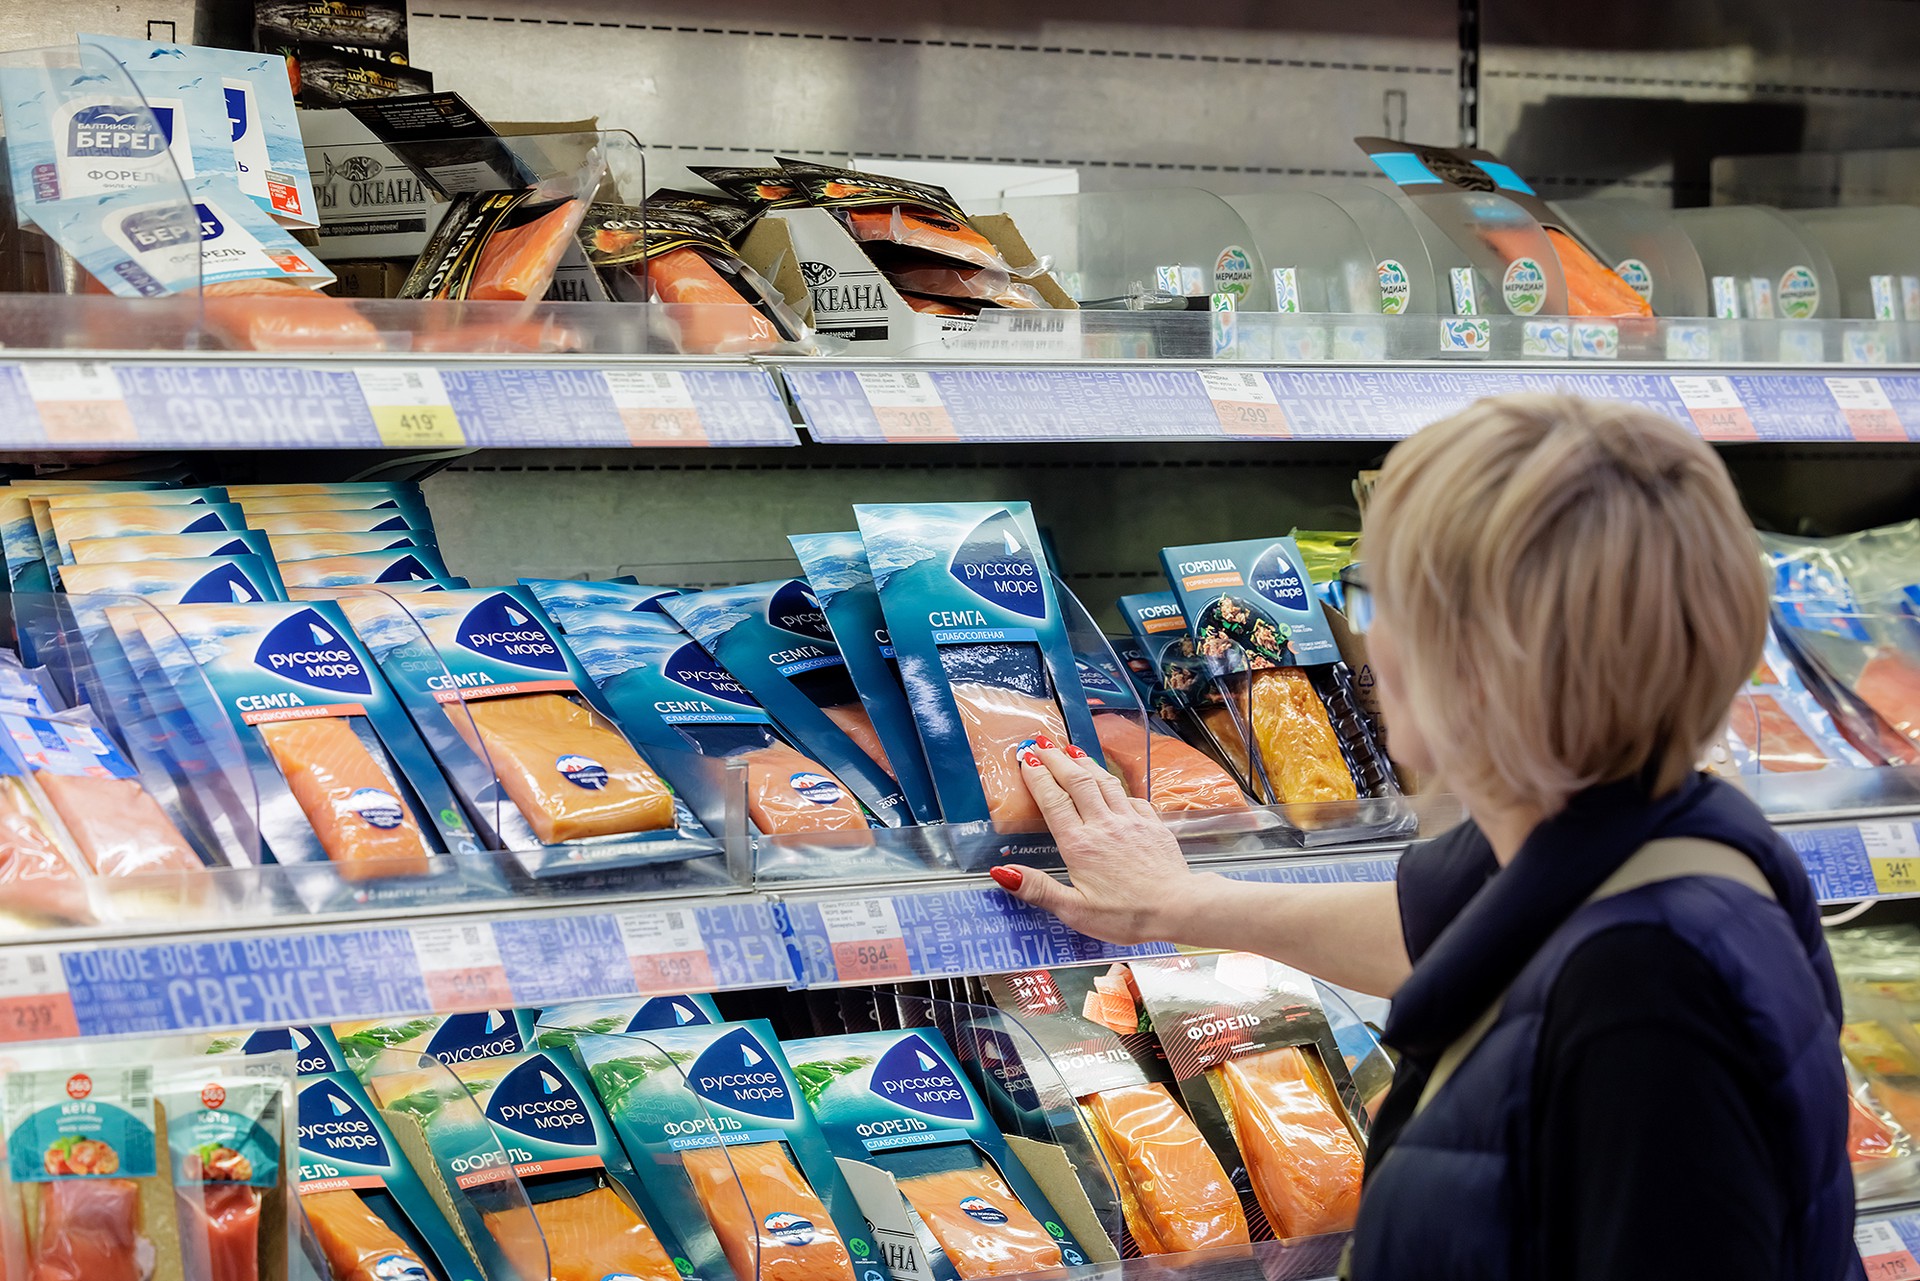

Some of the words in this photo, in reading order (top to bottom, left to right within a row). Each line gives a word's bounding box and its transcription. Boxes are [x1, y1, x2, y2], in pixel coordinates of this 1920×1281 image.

[76, 131, 161, 150] БЕРЕГ
[314, 183, 338, 209] РЫ
[350, 177, 426, 208] ОКЕАНА
[835, 177, 941, 204] ФОРЕЛЬ
[603, 219, 711, 238] ФОРЕЛЬ
[1215, 272, 1253, 282] МЕРИДИАН
[1380, 284, 1408, 295] РИДИАН
[1505, 282, 1544, 293] МЕРИДИАН
[811, 283, 889, 314] КЕАНА
[154, 368, 201, 395] ВСЕ
[215, 368, 236, 394] И
[242, 368, 341, 398] ВСЕГДА
[730, 371, 750, 397] И
[800, 371, 834, 396] СЕ
[955, 371, 1051, 393] КАЧЕСТВО
[1121, 372, 1206, 397] ВЫСОК
[1267, 372, 1290, 396] И
[1289, 372, 1365, 398] ВСЕГДА
[1377, 372, 1463, 394] КАЧЕСТВО
[1625, 375, 1655, 398] ВСЕ
[1656, 376, 1673, 398] И
[898, 411, 932, 427] 319
[1237, 406, 1268, 423] 299
[1283, 400, 1380, 435] ЕЖЕЕ
[963, 562, 1034, 581] русское
[1178, 558, 1237, 576] ГОРБУША
[993, 579, 1039, 597] море
[1256, 576, 1299, 591] русское
[1274, 585, 1303, 599] море
[780, 612, 824, 628] русск
[928, 609, 988, 628] СЕМГА
[1137, 603, 1181, 620] ГОРБУ
[469, 630, 546, 648] русское
[935, 630, 1005, 642] СЛАБОСОЛЕНАЯ
[504, 641, 555, 657] море
[768, 645, 825, 667] СЕМГА
[268, 649, 351, 669] русское
[305, 662, 360, 679] море
[676, 669, 736, 683] русско
[426, 671, 495, 690] СЕМГА
[711, 682, 752, 695] мор
[235, 692, 305, 712] СЕМГА
[654, 700, 715, 714] СЕМГА
[246, 706, 329, 724] ПОДКОПЧЕННАЯ
[665, 715, 736, 723] СЛАБОСОЛЕНАЯ
[879, 797, 898, 810] 200
[960, 823, 980, 836] 200
[1886, 861, 1911, 878] 341
[699, 905, 725, 935] СЕ
[727, 904, 750, 933] И
[953, 918, 973, 937] ЗА
[973, 912, 1046, 936] РАЗУМНЫЕ
[61, 949, 150, 984] СОКОЕ
[157, 942, 210, 977] ВСЕ
[217, 941, 238, 972] И
[243, 933, 343, 972] ВСЕГДА
[857, 944, 889, 965] 584
[960, 934, 1055, 975] ДЕНЬГИ
[658, 957, 692, 978] 899
[1012, 973, 1047, 988] PRE
[166, 967, 355, 1029] СВЕЖЕЕ
[1018, 984, 1053, 999] MIU
[1045, 996, 1060, 1006] M
[15, 1004, 54, 1028] 239
[1186, 1013, 1261, 1041] ФОРЕЛЬ
[435, 1038, 516, 1066] русское
[1055, 1048, 1131, 1073] ФОРЕЛЬ
[700, 1070, 777, 1092] русское
[882, 1074, 954, 1095] русское
[734, 1084, 784, 1102] море
[915, 1088, 962, 1105] море
[499, 1097, 578, 1121] русское
[534, 1112, 586, 1130] море
[663, 1116, 742, 1136] ФОРЕЛЬ
[855, 1117, 928, 1138] ФОРЕЛЬ
[325, 1134, 378, 1151] море
[866, 1133, 936, 1149] СЛАБОСОЛЕНАЯ
[450, 1147, 533, 1174] ФОРЕЛЬ
[299, 1178, 350, 1192] ОПЧЕННАЯ
[1880, 1258, 1906, 1273] 179
